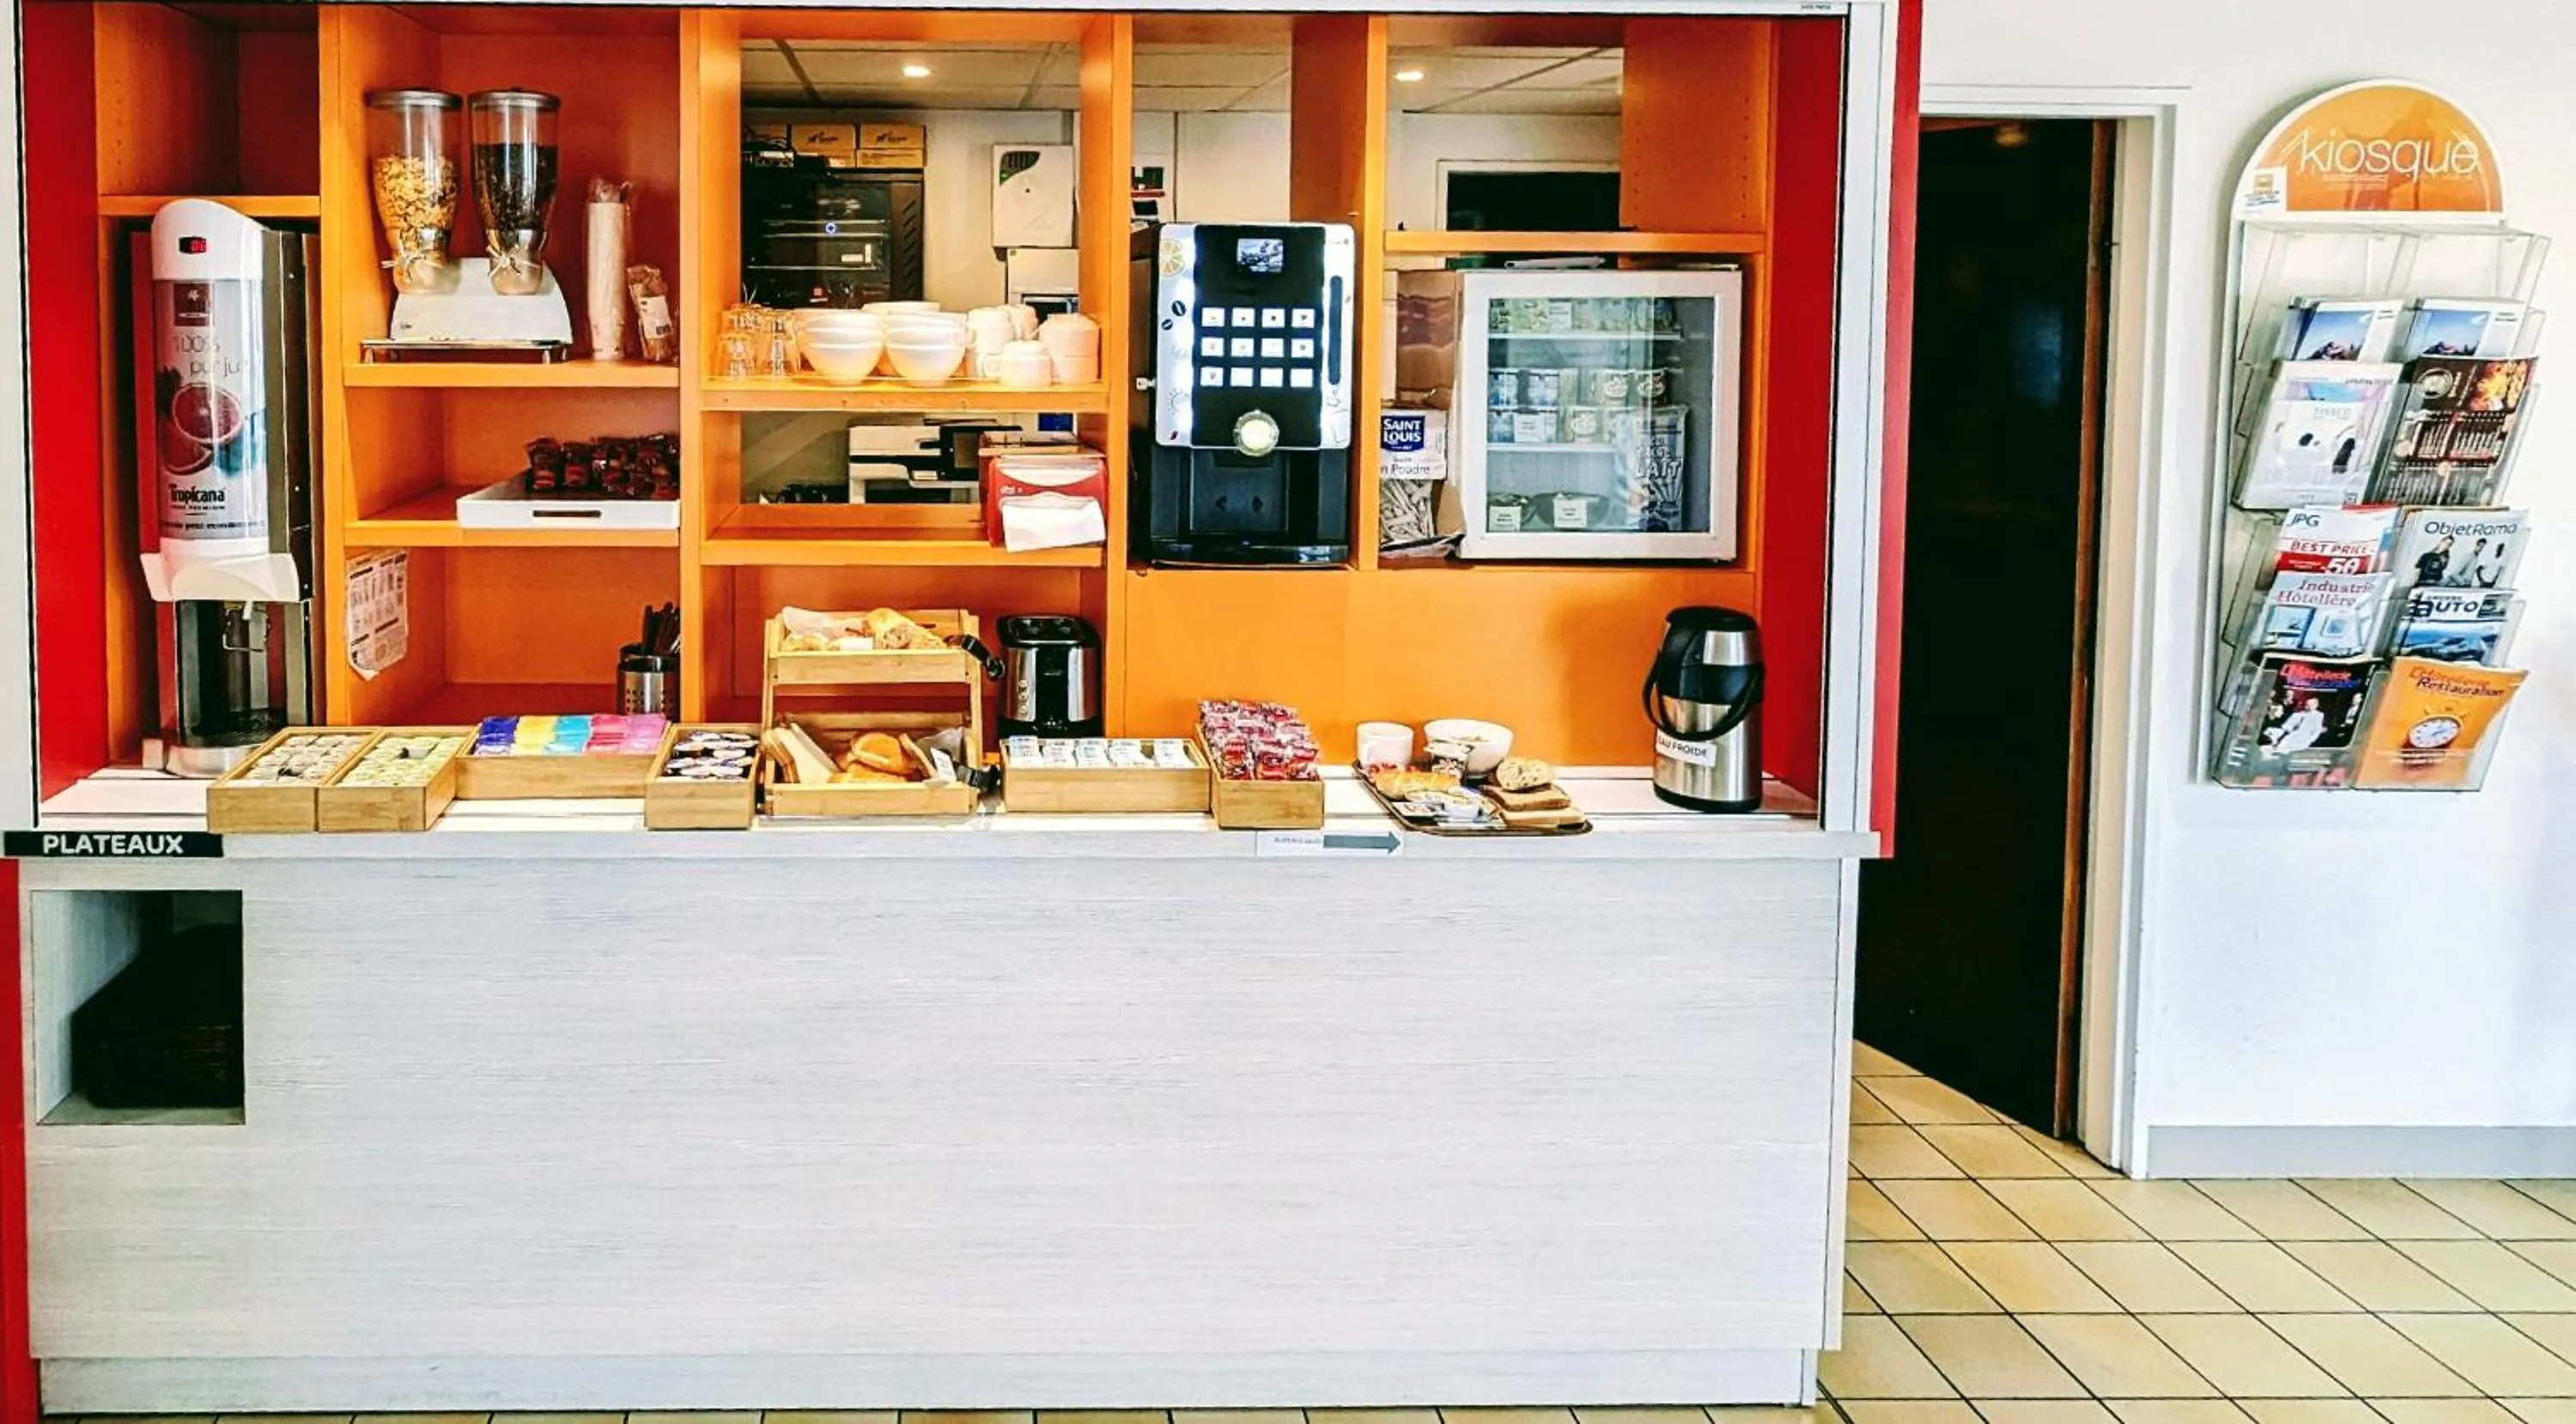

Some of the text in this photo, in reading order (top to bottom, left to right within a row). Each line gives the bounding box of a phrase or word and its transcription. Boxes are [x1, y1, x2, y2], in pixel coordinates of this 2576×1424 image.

[1383, 418, 1422, 430] SAINT
[1384, 430, 1423, 445] LOUIS
[1391, 464, 1431, 475] Poudre
[168, 483, 226, 504] Tropicana
[2287, 513, 2322, 526] JPG
[2291, 540, 2329, 553] BEST
[2416, 675, 2505, 698] Restauration
[1672, 741, 1707, 757] FROIDE
[43, 834, 184, 855] PLATEAUX
